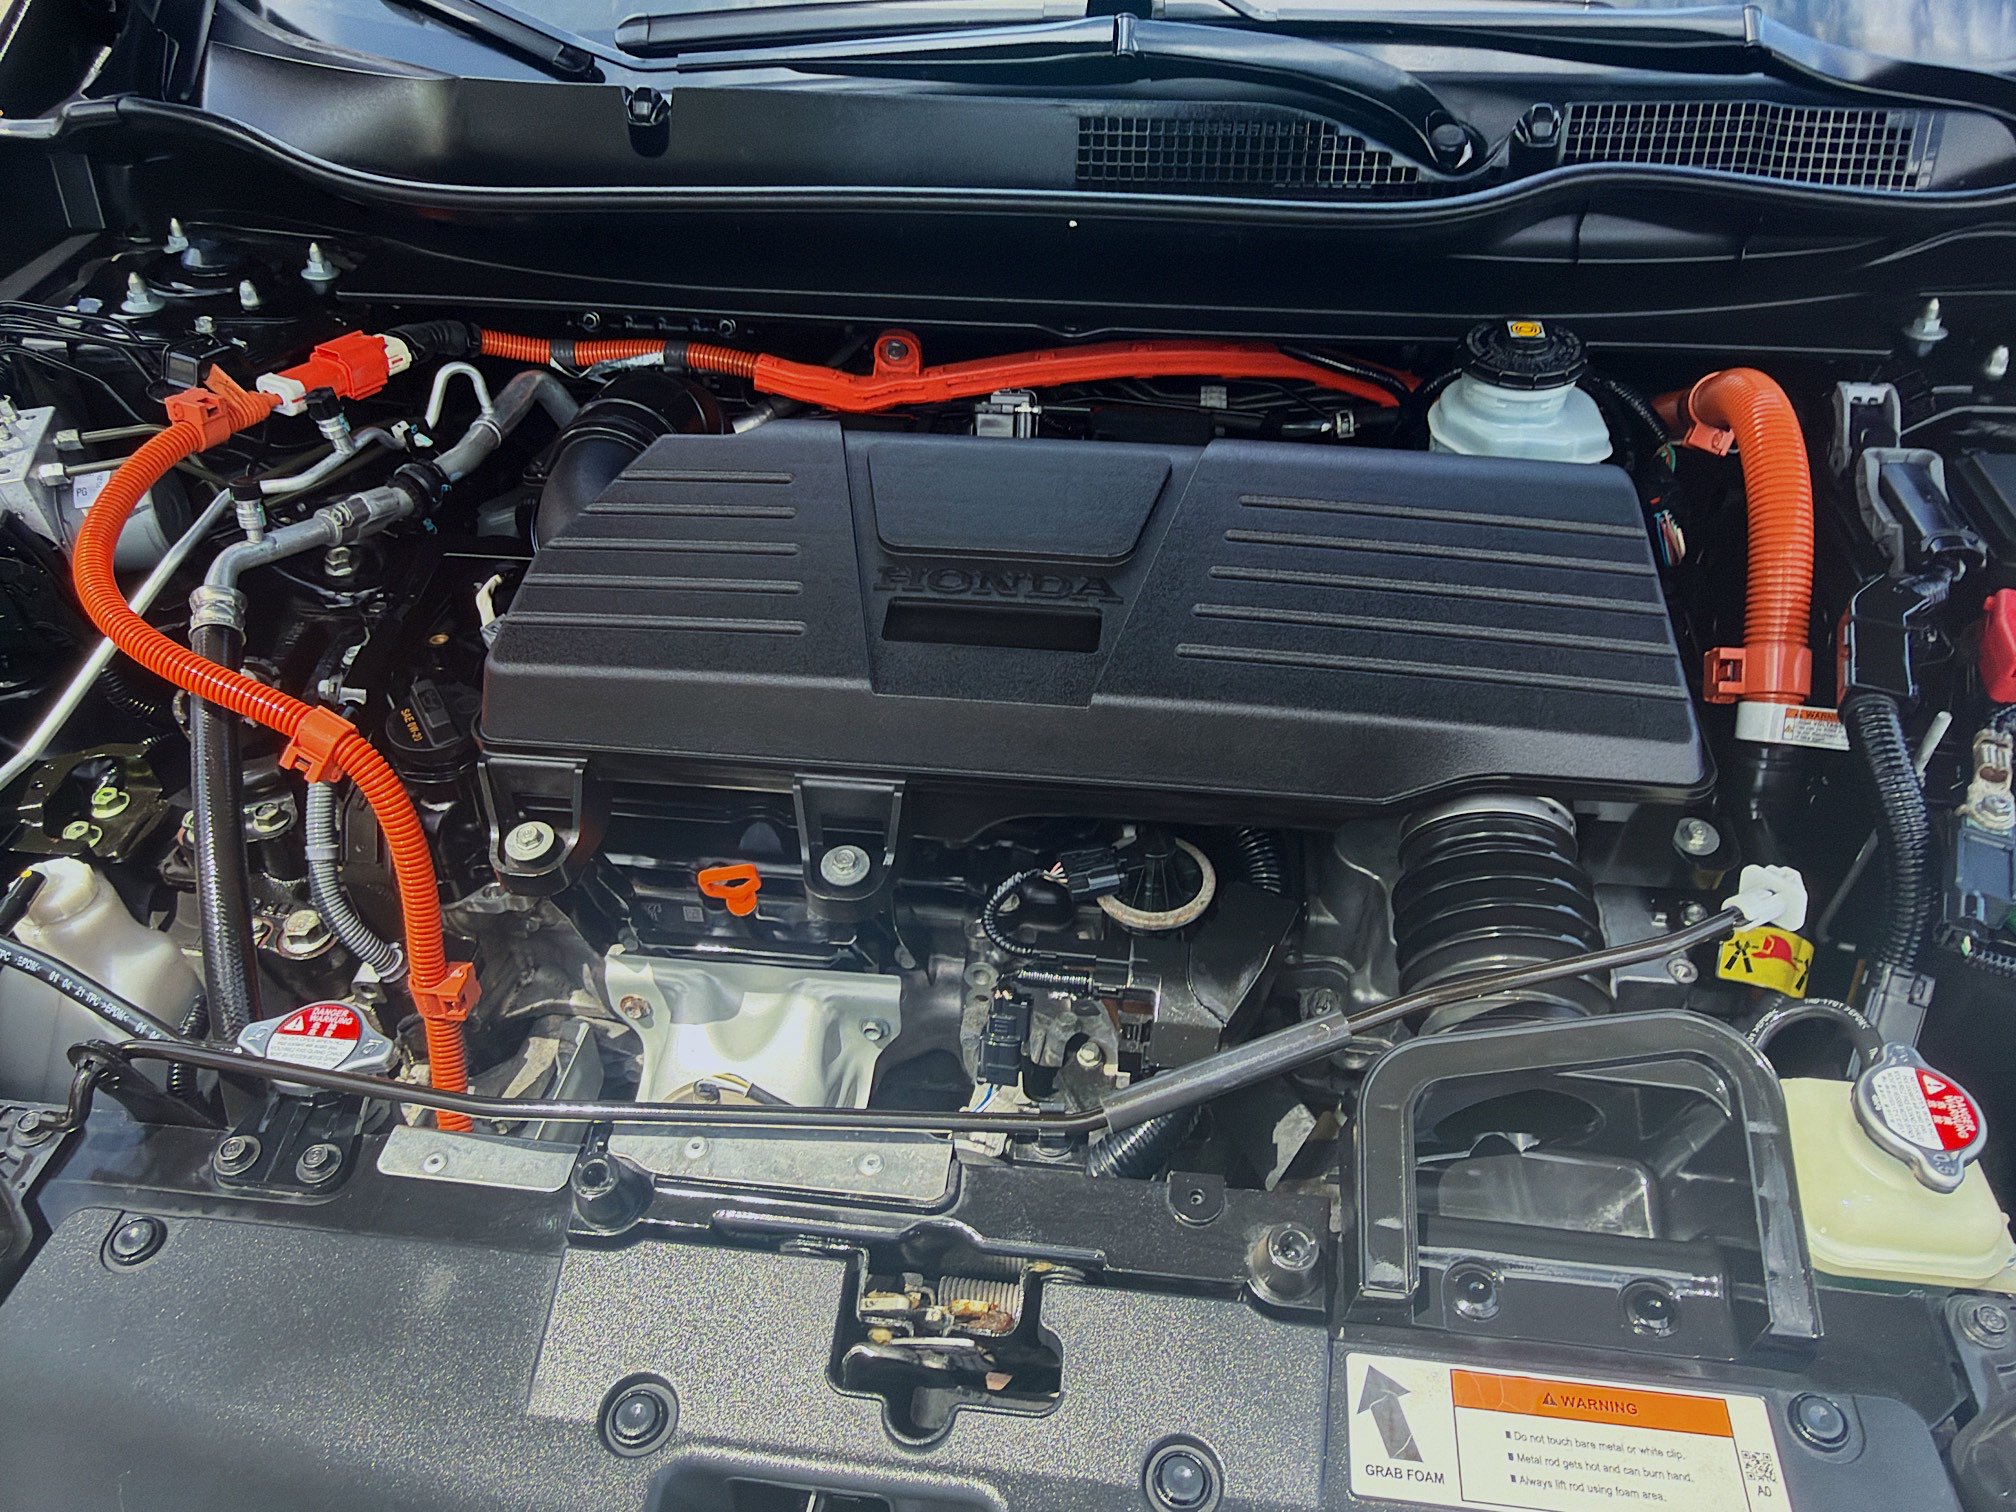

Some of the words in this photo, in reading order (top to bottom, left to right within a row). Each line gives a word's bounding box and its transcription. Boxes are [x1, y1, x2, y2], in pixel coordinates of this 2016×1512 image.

[873, 566, 1124, 604] HONDA
[312, 1007, 349, 1017] DANGER
[1953, 1095, 1977, 1132] DANGER
[1560, 1395, 1638, 1415] WARNING
[1513, 1431, 1527, 1441] Do
[1530, 1433, 1545, 1444] not
[1547, 1435, 1573, 1447] touch
[1575, 1438, 1596, 1449] bare
[1599, 1440, 1624, 1452] metal
[1639, 1444, 1664, 1456] white
[1365, 1464, 1403, 1480] GRAB
[1407, 1469, 1445, 1484] FOAM
[1517, 1453, 1542, 1465] Metal
[1545, 1456, 1560, 1467] rod
[1563, 1459, 1583, 1470] gets
[1586, 1460, 1600, 1472] hot
[1603, 1463, 1620, 1474] and
[1623, 1467, 1640, 1477] can
[1643, 1466, 1665, 1479] burn
[1519, 1475, 1552, 1490] Always
[1555, 1479, 1567, 1491] lift
[1569, 1480, 1585, 1492] rod
[1588, 1484, 1613, 1498] using
[1615, 1486, 1640, 1499] foam
